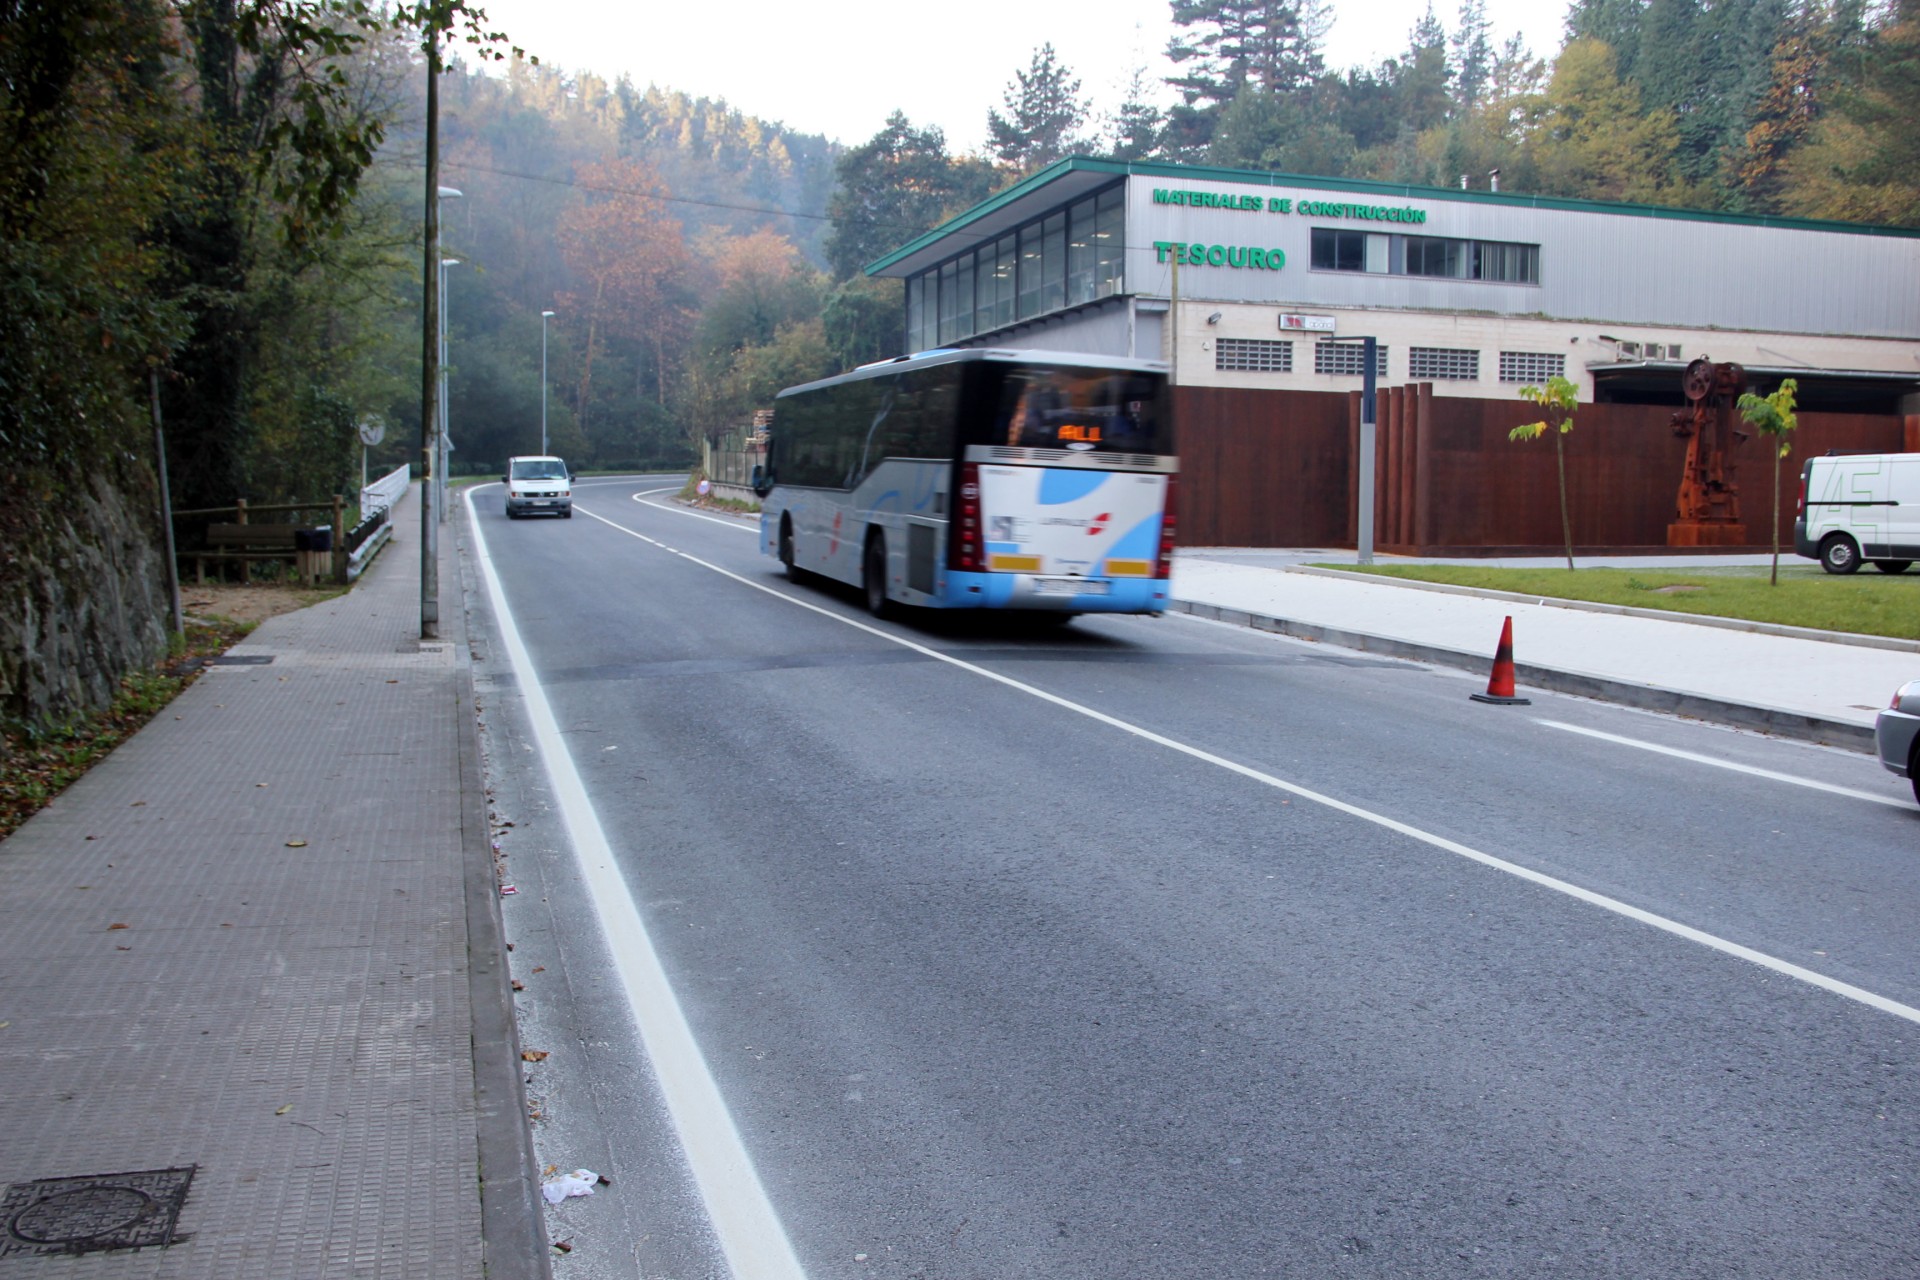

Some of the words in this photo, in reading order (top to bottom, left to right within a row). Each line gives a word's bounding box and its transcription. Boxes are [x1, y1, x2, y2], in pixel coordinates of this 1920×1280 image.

[1153, 189, 1264, 211] MATERIALES
[1269, 198, 1293, 213] DE
[1297, 200, 1427, 223] CONSTRUCCIÓN
[1153, 241, 1286, 270] TESOURO
